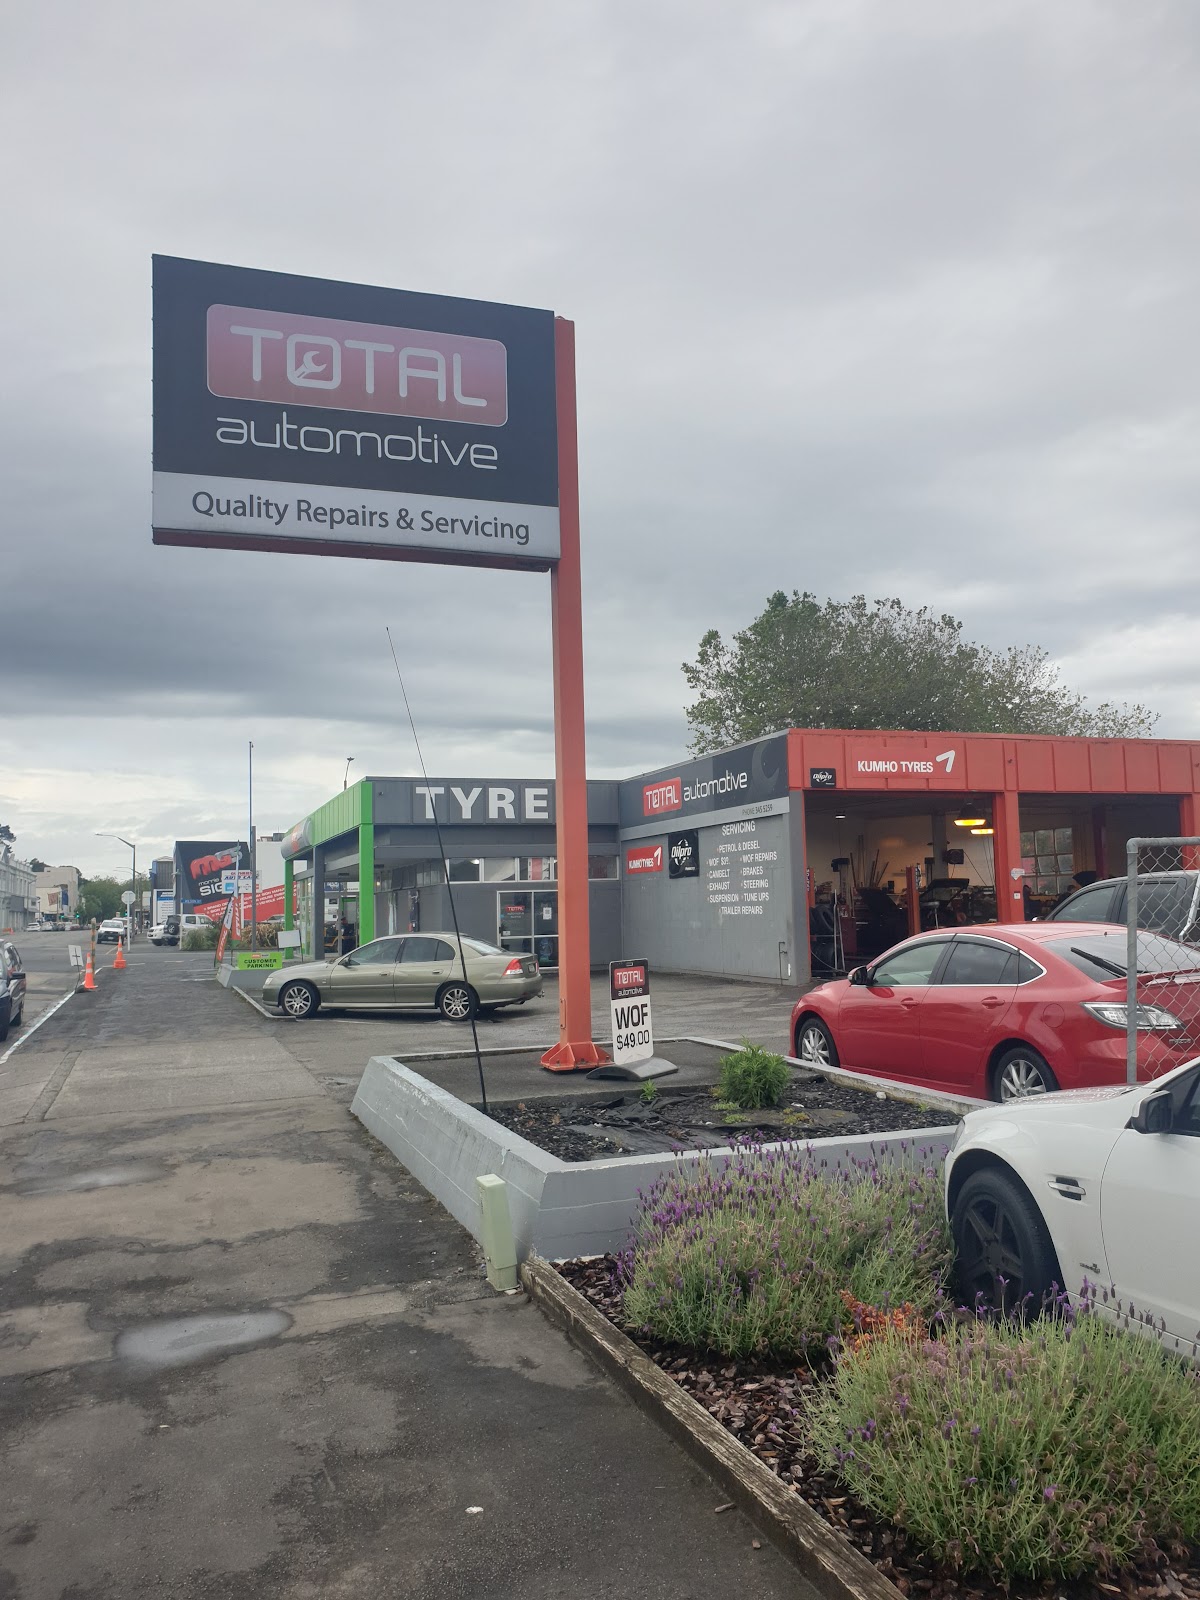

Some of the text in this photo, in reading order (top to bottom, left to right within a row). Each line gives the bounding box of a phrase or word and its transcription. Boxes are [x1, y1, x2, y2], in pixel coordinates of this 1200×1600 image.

[229, 325, 487, 407] TOTAL
[215, 411, 498, 470] automotive
[191, 490, 530, 546] Quality Repairs & Servicing
[857, 760, 934, 773] KUMHO TYRES
[645, 769, 748, 810] TOTAL automotive
[415, 786, 549, 819] TYRE
[721, 820, 756, 837] SERVICING
[671, 845, 692, 860] Oilpro
[718, 843, 738, 853] PETROL
[742, 840, 760, 851] DIESEL
[742, 851, 778, 864] WOF REPAIRS
[709, 868, 730, 879] CAMBELT
[742, 866, 764, 876] BRAKES
[709, 881, 731, 891] EXHAUST
[743, 879, 769, 889] STEERING
[709, 893, 739, 903] SUSPENSION
[743, 892, 770, 902] TUNE UPS
[720, 905, 764, 915] TRAILER REPAIRS
[616, 970, 644, 985] TOTAL
[618, 986, 643, 996] automotive
[615, 1003, 648, 1030] WOF
[616, 1029, 650, 1052] $49.00
